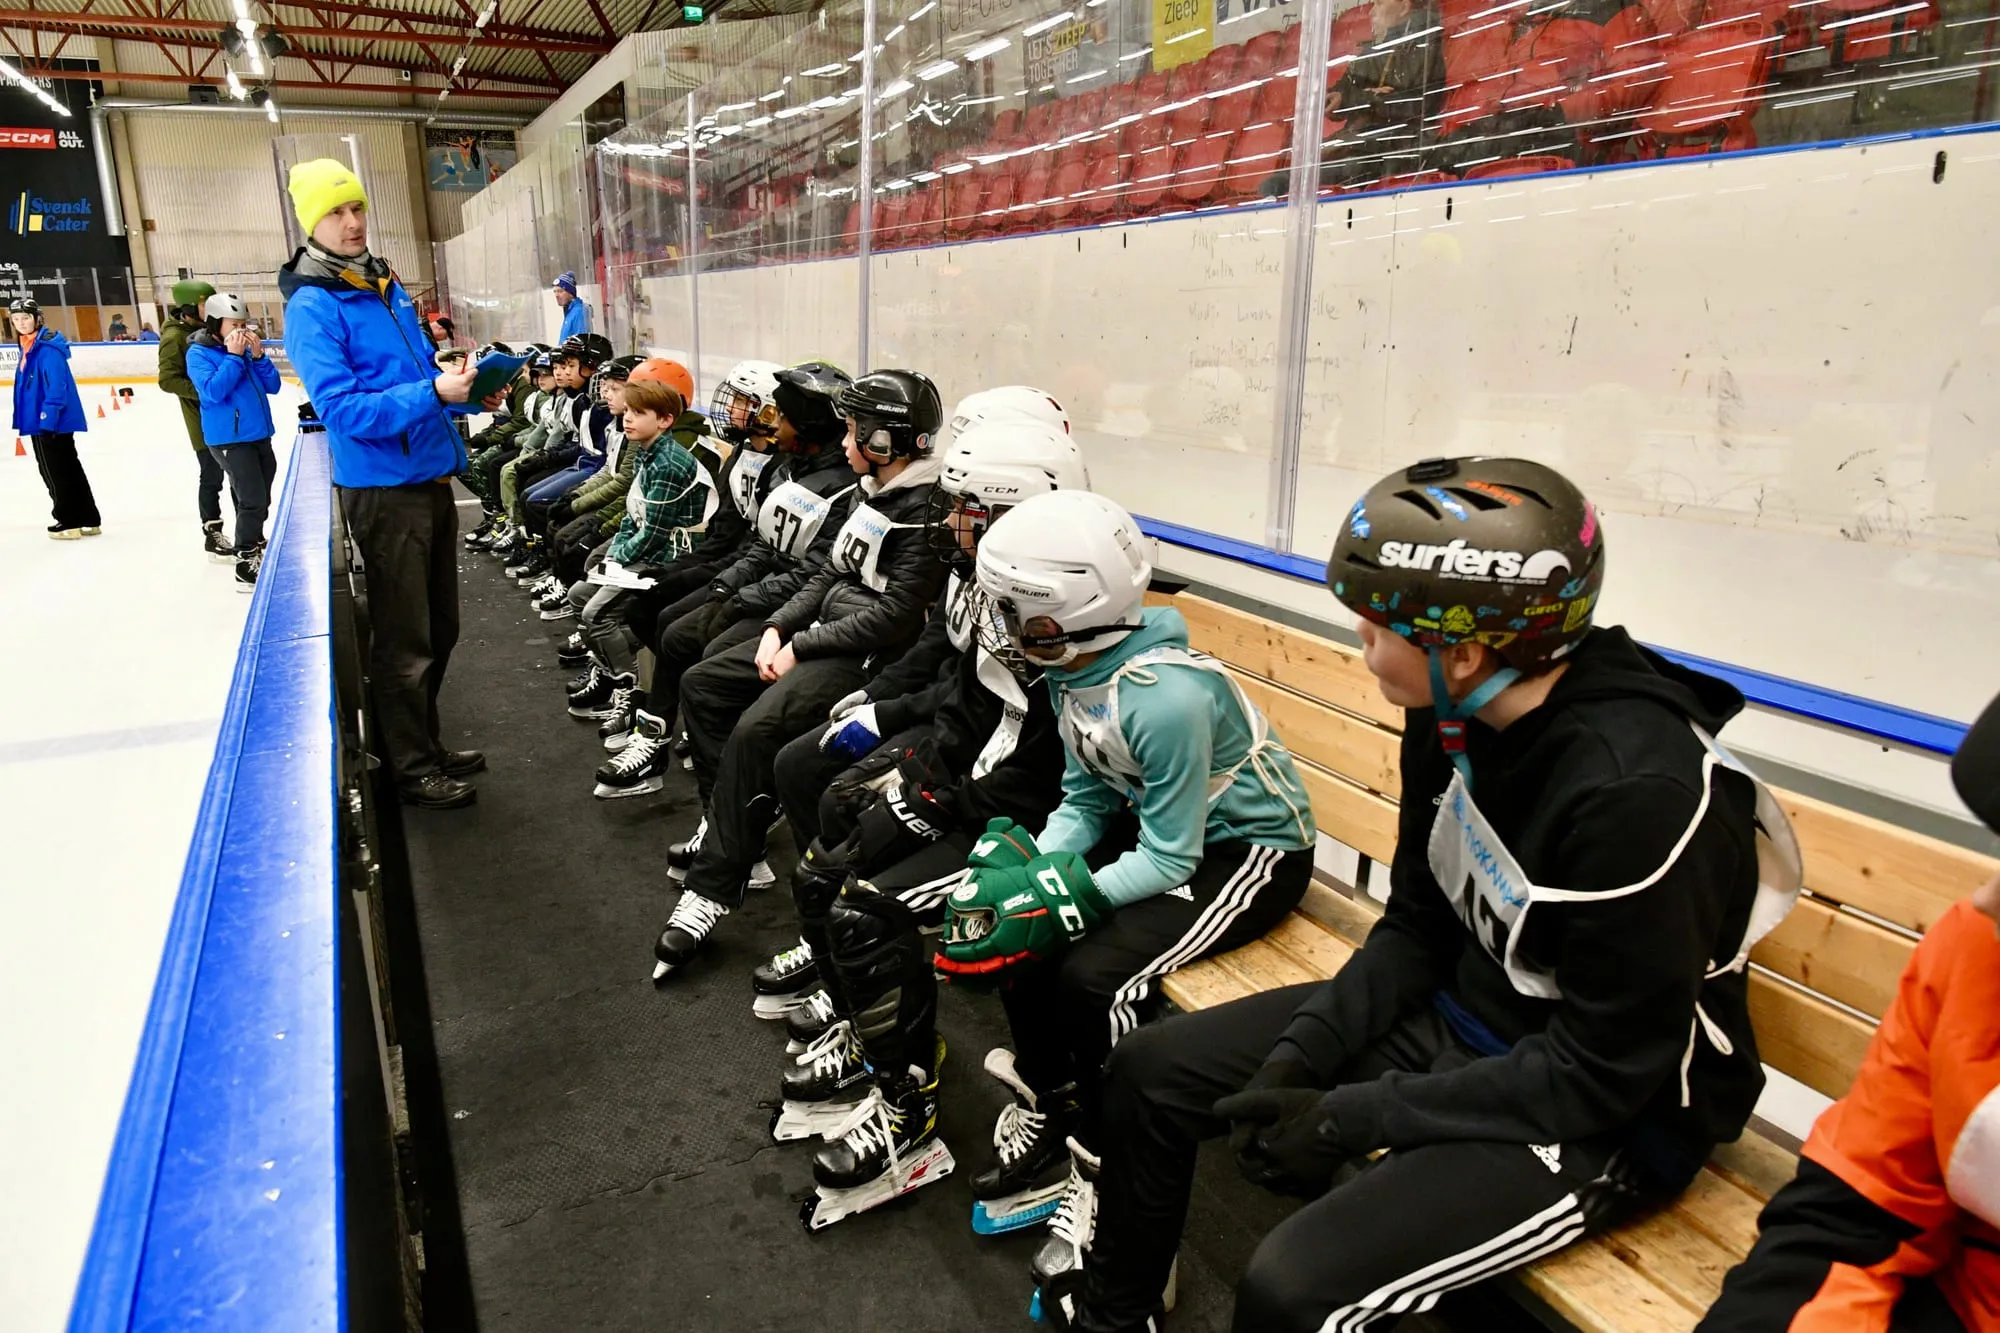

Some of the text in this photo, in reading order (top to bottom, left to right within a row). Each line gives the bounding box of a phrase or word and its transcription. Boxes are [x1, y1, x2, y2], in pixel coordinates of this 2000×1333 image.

[1164, 0, 1199, 25] Zleep
[1054, 24, 1086, 51] ZLEEP
[58, 131, 79, 140] ALL
[58, 139, 85, 149] OUT.
[30, 198, 92, 214] Svensk
[43, 215, 90, 231] Cater
[876, 404, 908, 414] BAUER
[983, 486, 1019, 495] CCM
[769, 505, 802, 554] 37
[1378, 539, 1525, 578] surfers
[1011, 586, 1050, 599] BAUER
[886, 786, 945, 841] AUER
[1036, 862, 1086, 943] CC
